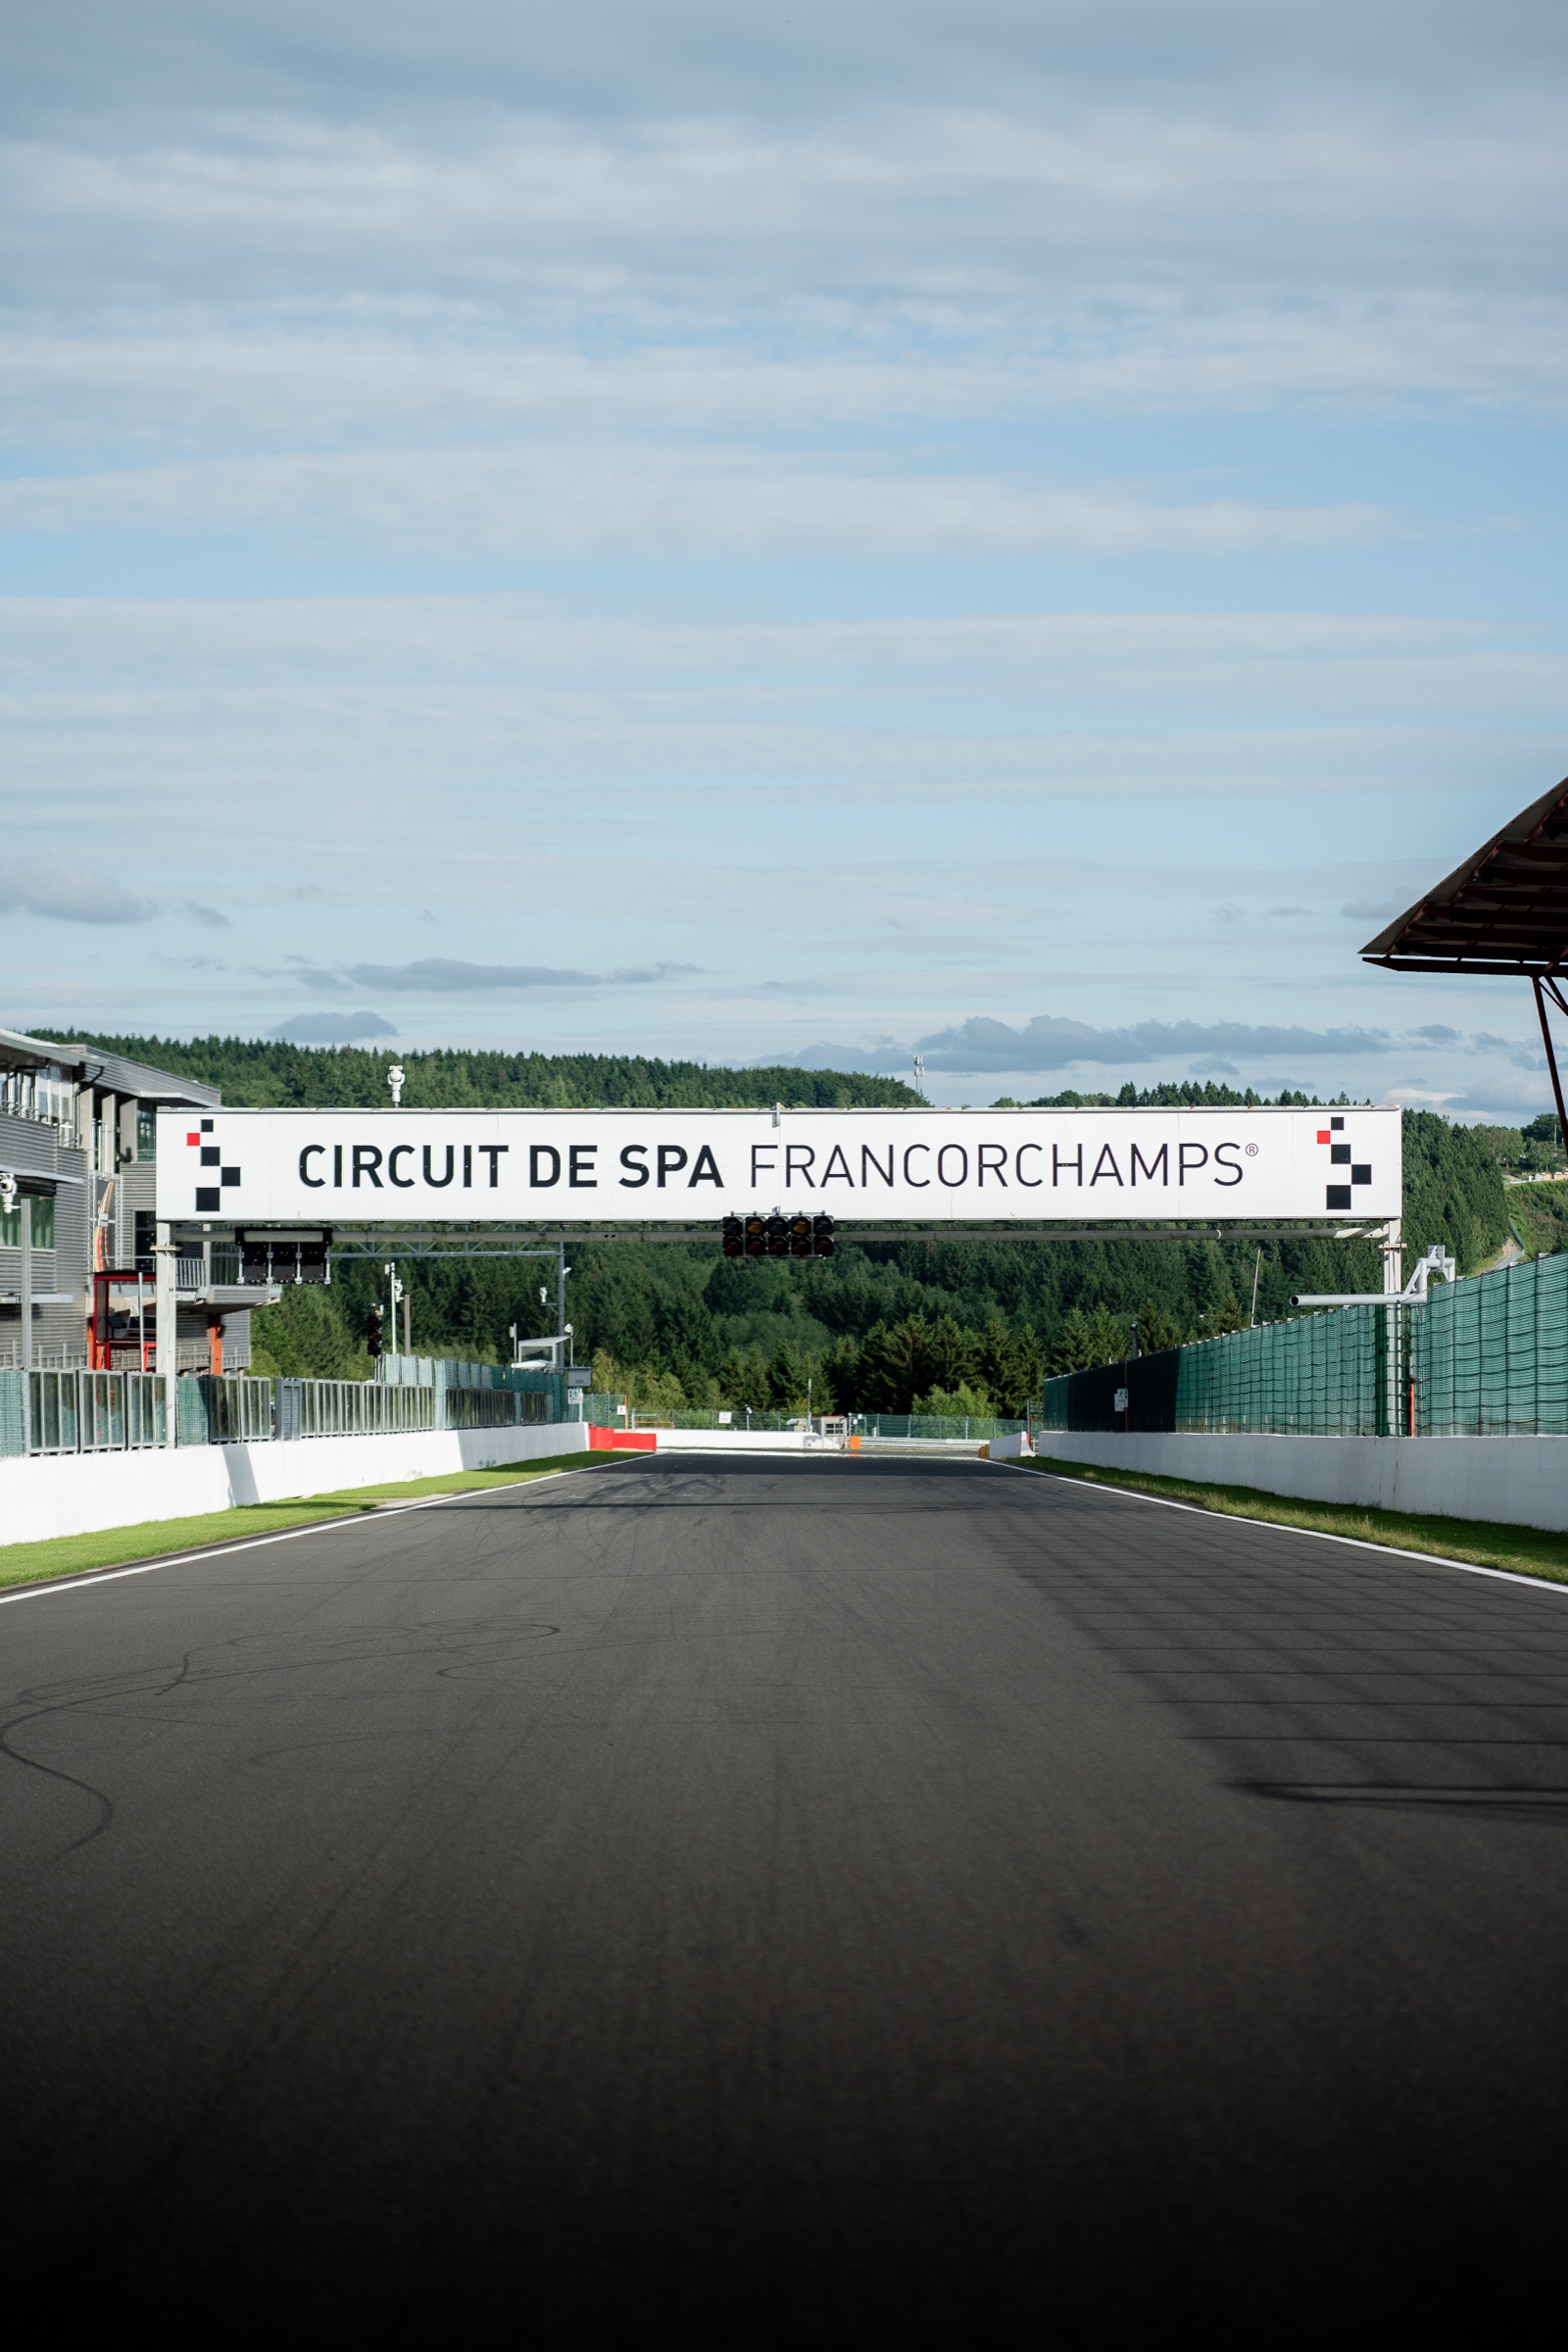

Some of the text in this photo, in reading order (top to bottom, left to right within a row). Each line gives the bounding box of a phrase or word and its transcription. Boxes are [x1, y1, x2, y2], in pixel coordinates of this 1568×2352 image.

[299, 1145, 510, 1188] CIRCUIT
[529, 1145, 598, 1188] DE
[617, 1145, 725, 1188] SPA
